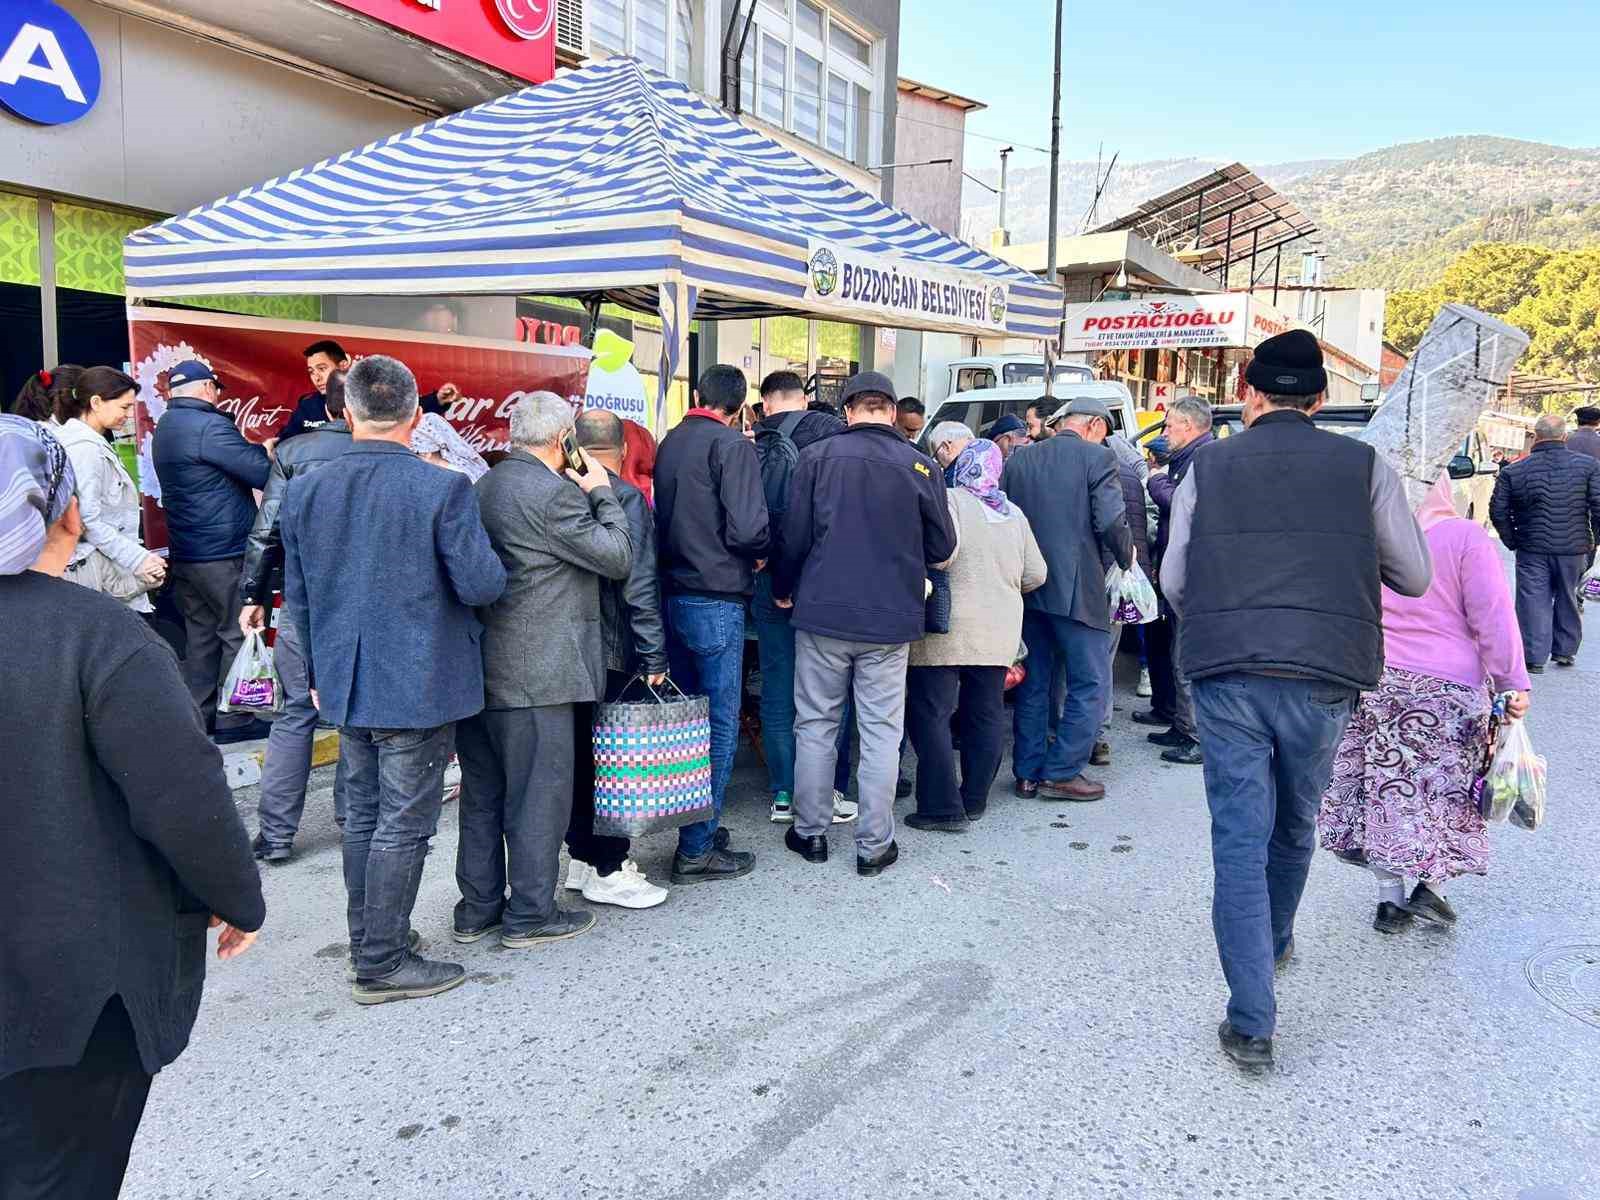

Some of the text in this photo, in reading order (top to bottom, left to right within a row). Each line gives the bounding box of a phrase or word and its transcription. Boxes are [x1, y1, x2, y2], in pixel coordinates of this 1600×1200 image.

[0, 23, 88, 104] A
[841, 263, 918, 311] BOZDOĞAN
[921, 279, 988, 321] BELEDİYESİ
[1083, 309, 1235, 331] POSTACIOĞLU
[216, 395, 293, 441] Mart
[586, 393, 645, 412] DOĞRUSU
